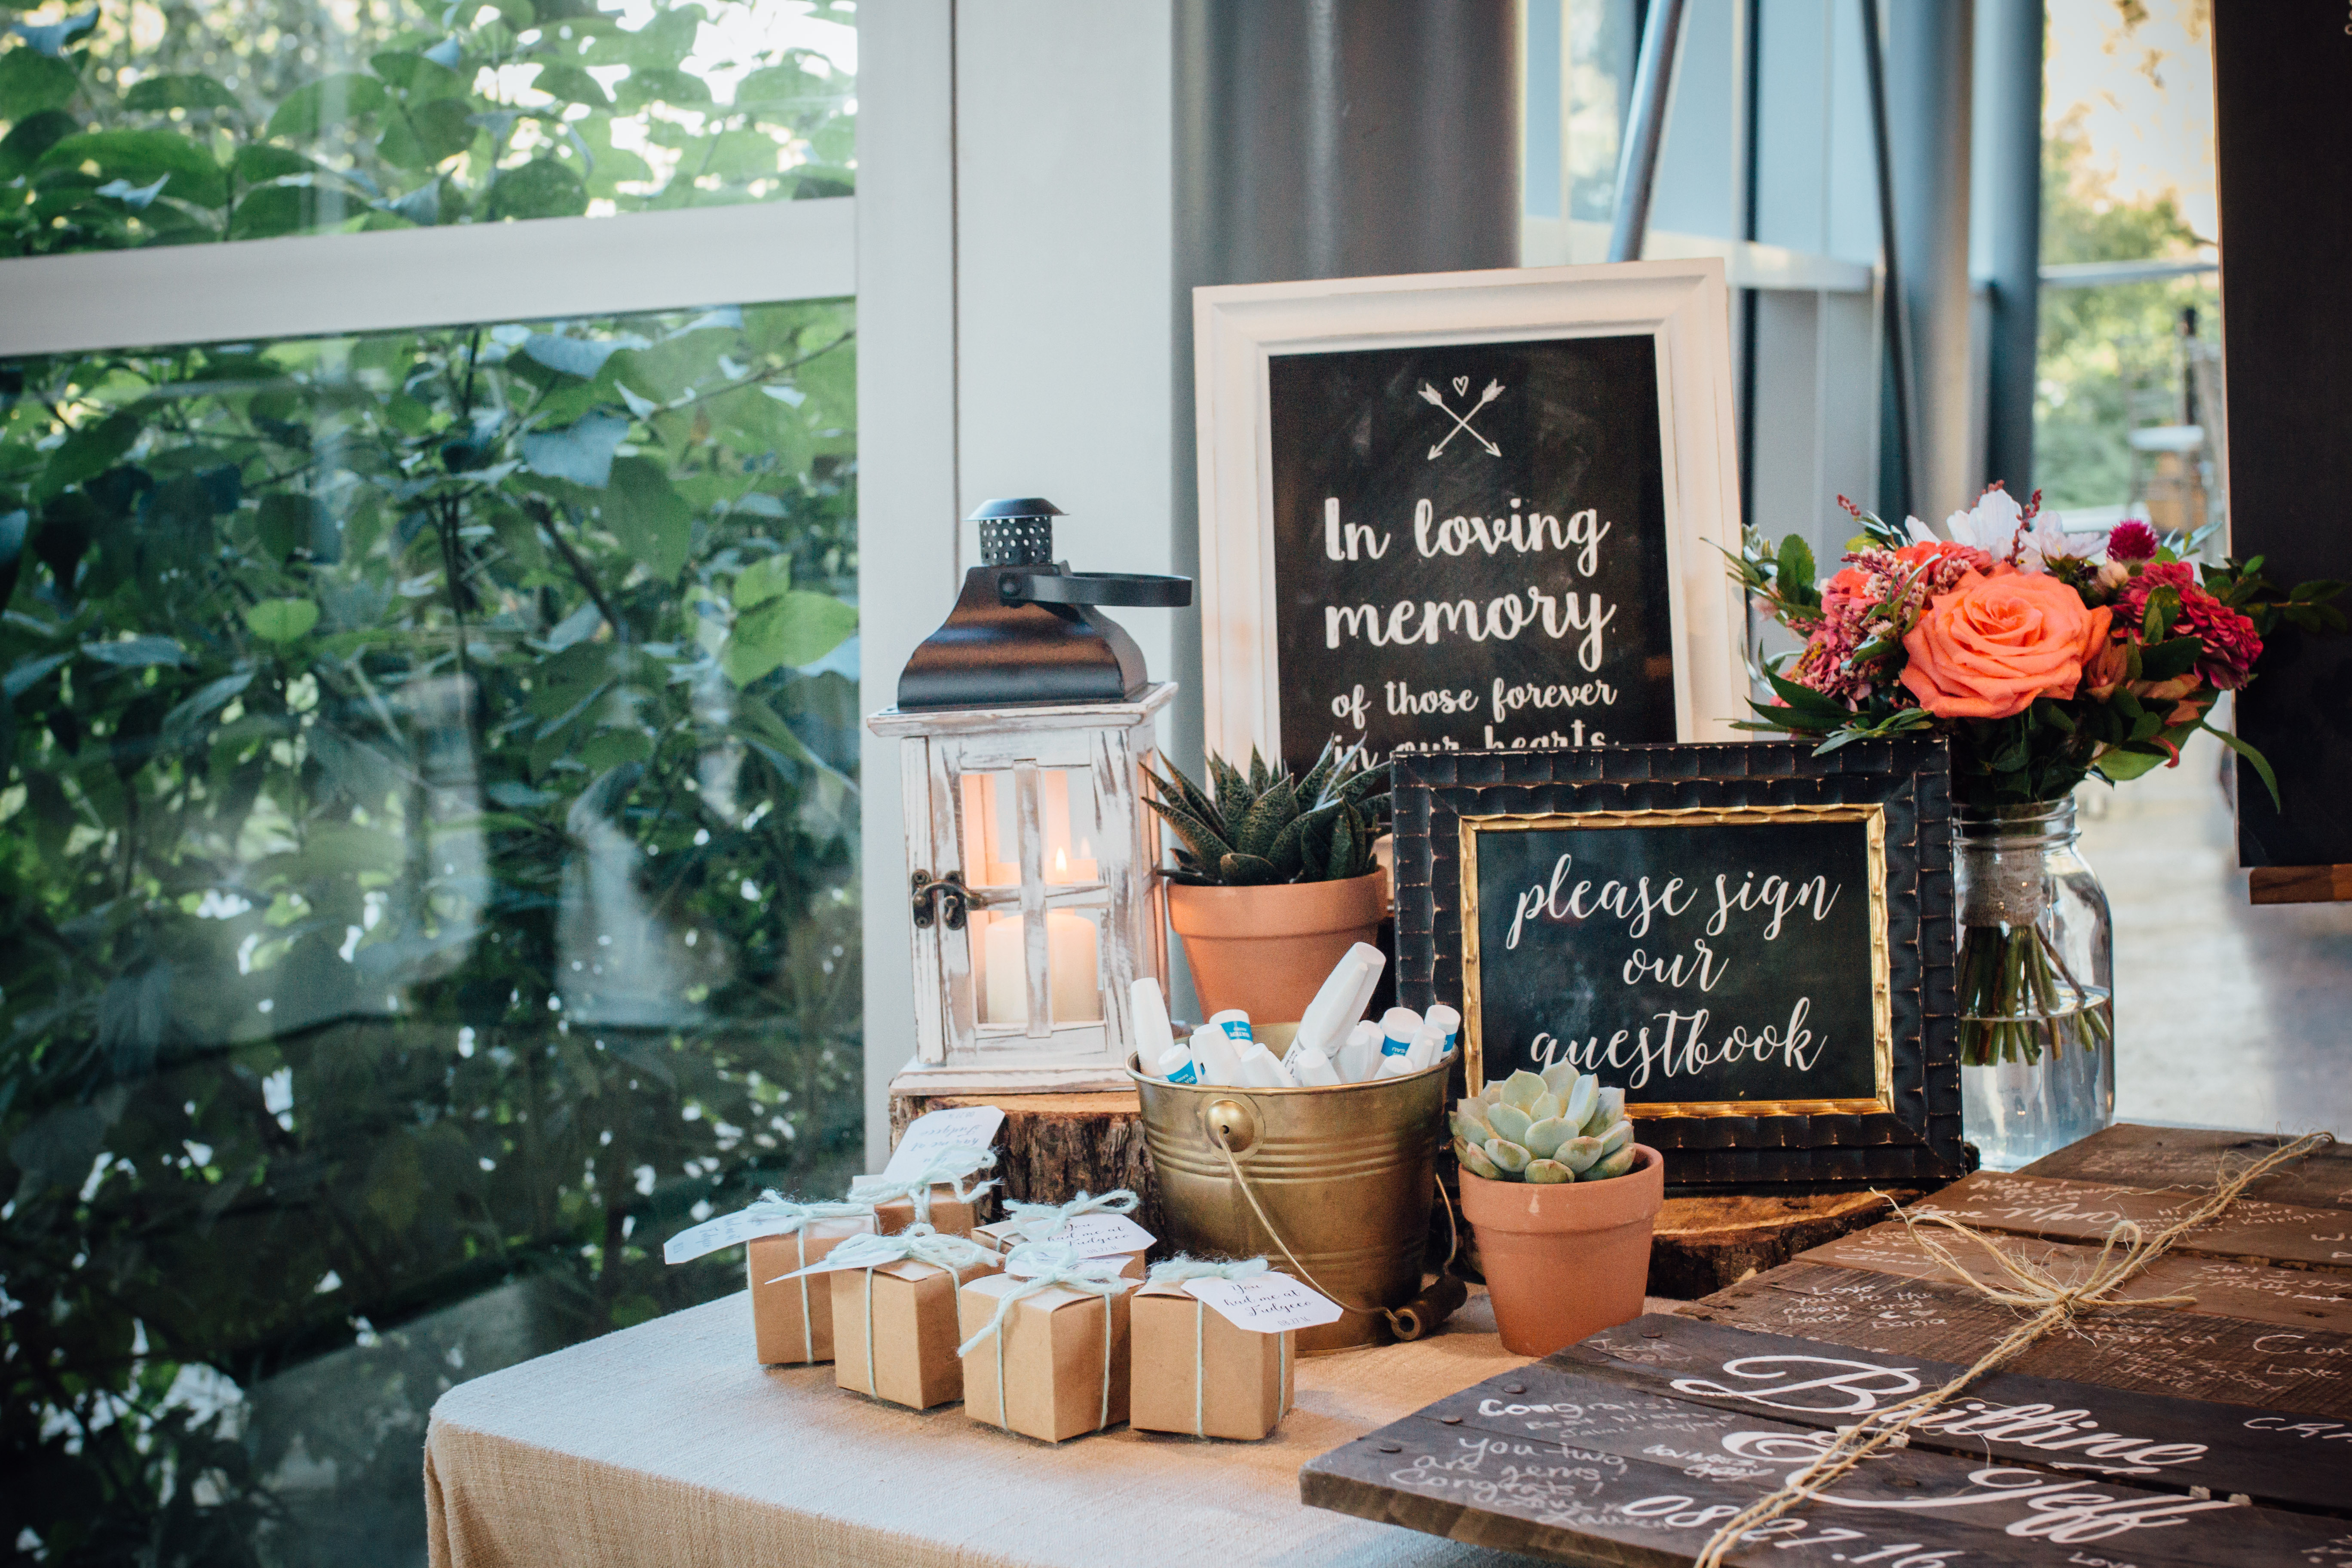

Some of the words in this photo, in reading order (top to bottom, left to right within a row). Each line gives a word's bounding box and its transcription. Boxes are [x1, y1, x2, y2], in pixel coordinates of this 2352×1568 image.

[1325, 497, 1390, 560] In
[1414, 498, 1611, 576] loving
[1326, 586, 1617, 672] memory
[1332, 683, 1371, 729] of
[1384, 680, 1479, 715] those
[1492, 677, 1617, 723] forever
[1506, 853, 1697, 950] please
[1706, 871, 1841, 940] sign
[1623, 938, 1730, 992] our
[1531, 997, 1828, 1089] guestbook
[1047, 1232, 1078, 1242] had
[1064, 1223, 1094, 1232] You
[1223, 1295, 1256, 1306] had
[1228, 1283, 1262, 1294] You
[1782, 1305, 1850, 1314] moon
[1869, 1300, 1923, 1310] and
[1786, 1313, 1853, 1324] back
